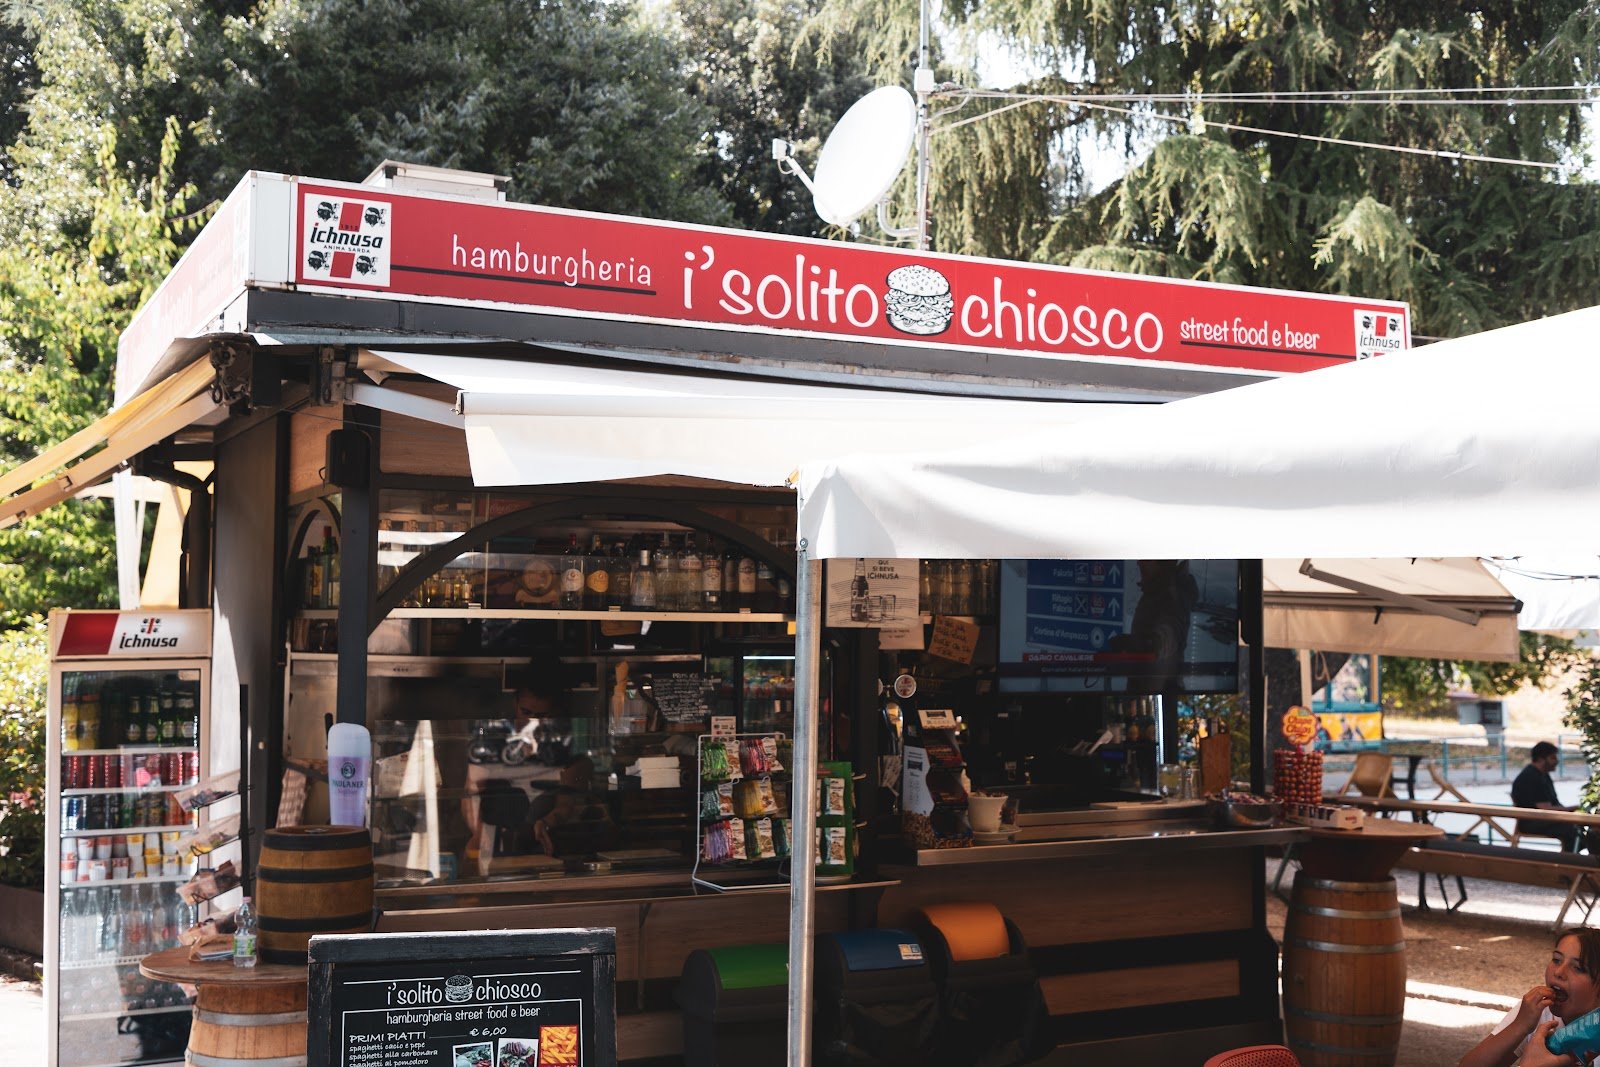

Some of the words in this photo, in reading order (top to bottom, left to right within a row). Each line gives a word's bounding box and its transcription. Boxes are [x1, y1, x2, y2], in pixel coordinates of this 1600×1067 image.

[310, 222, 383, 249] ichnusa
[452, 233, 651, 287] hamburgheria
[960, 276, 1164, 353] chiosco
[1180, 316, 1229, 342] street
[1232, 317, 1268, 347] food
[1272, 329, 1282, 347] e
[1285, 322, 1321, 350] beer
[1359, 331, 1400, 349] ichnusa
[867, 572, 899, 580] ICHNUSA
[119, 632, 178, 649] ichnusa
[476, 978, 541, 1000] chiosco
[386, 1010, 452, 1026] hamburgheria
[455, 1009, 483, 1020] street
[487, 1005, 508, 1019] food
[510, 1009, 517, 1017] e
[520, 1005, 541, 1017] beer
[349, 1034, 384, 1043] PRIMI
[387, 1031, 426, 1041] PIATTI
[482, 1026, 507, 1036] 6,00
[349, 1043, 383, 1053] spaghetti
[385, 1041, 403, 1050] cacio
[411, 1042, 425, 1051] pepe
[349, 1051, 383, 1062] spaghetti
[401, 1049, 438, 1058] carbonara
[393, 1058, 429, 1067] pomodoro
